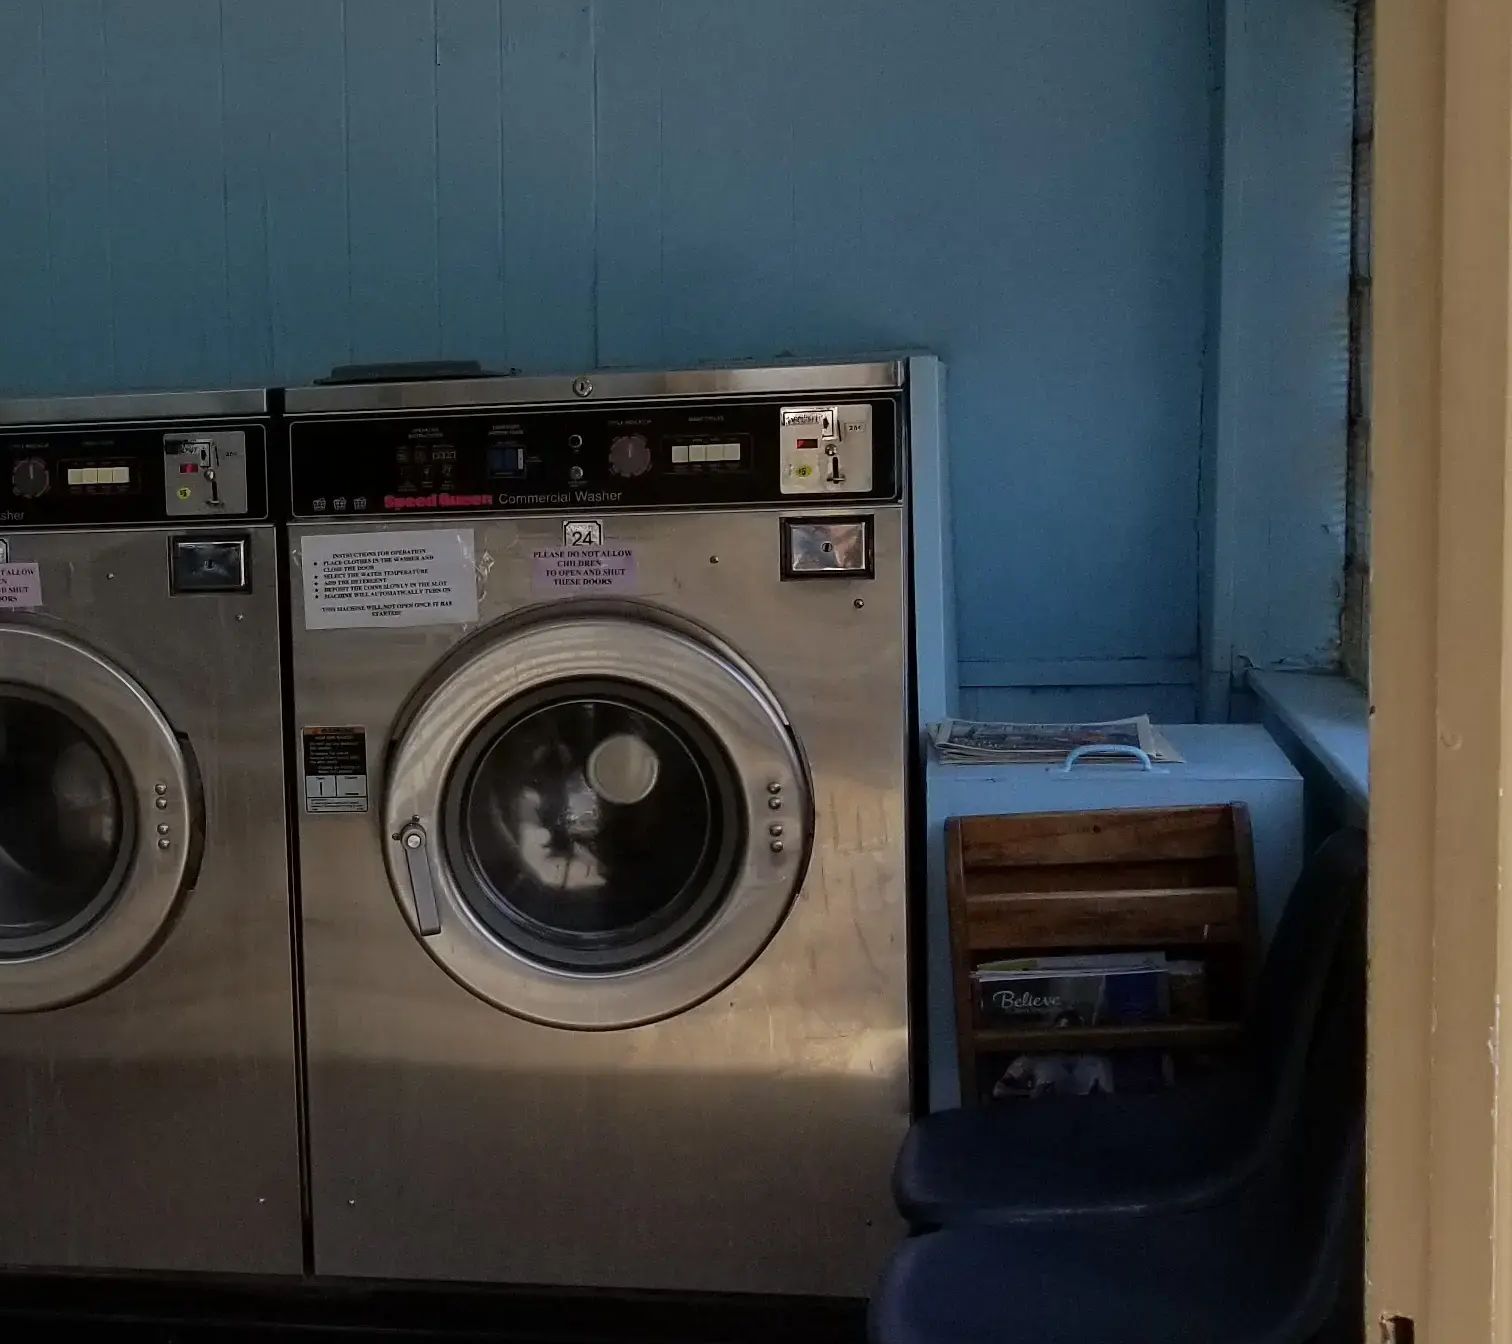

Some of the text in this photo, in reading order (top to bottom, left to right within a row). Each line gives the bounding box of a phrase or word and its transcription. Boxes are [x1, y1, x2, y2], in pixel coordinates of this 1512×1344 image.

[498, 492, 571, 505] Commercial
[573, 489, 622, 503] Washer
[572, 531, 595, 546] 24
[371, 589, 424, 598] AUTOMATICALLY
[992, 990, 1062, 1009] Believe
